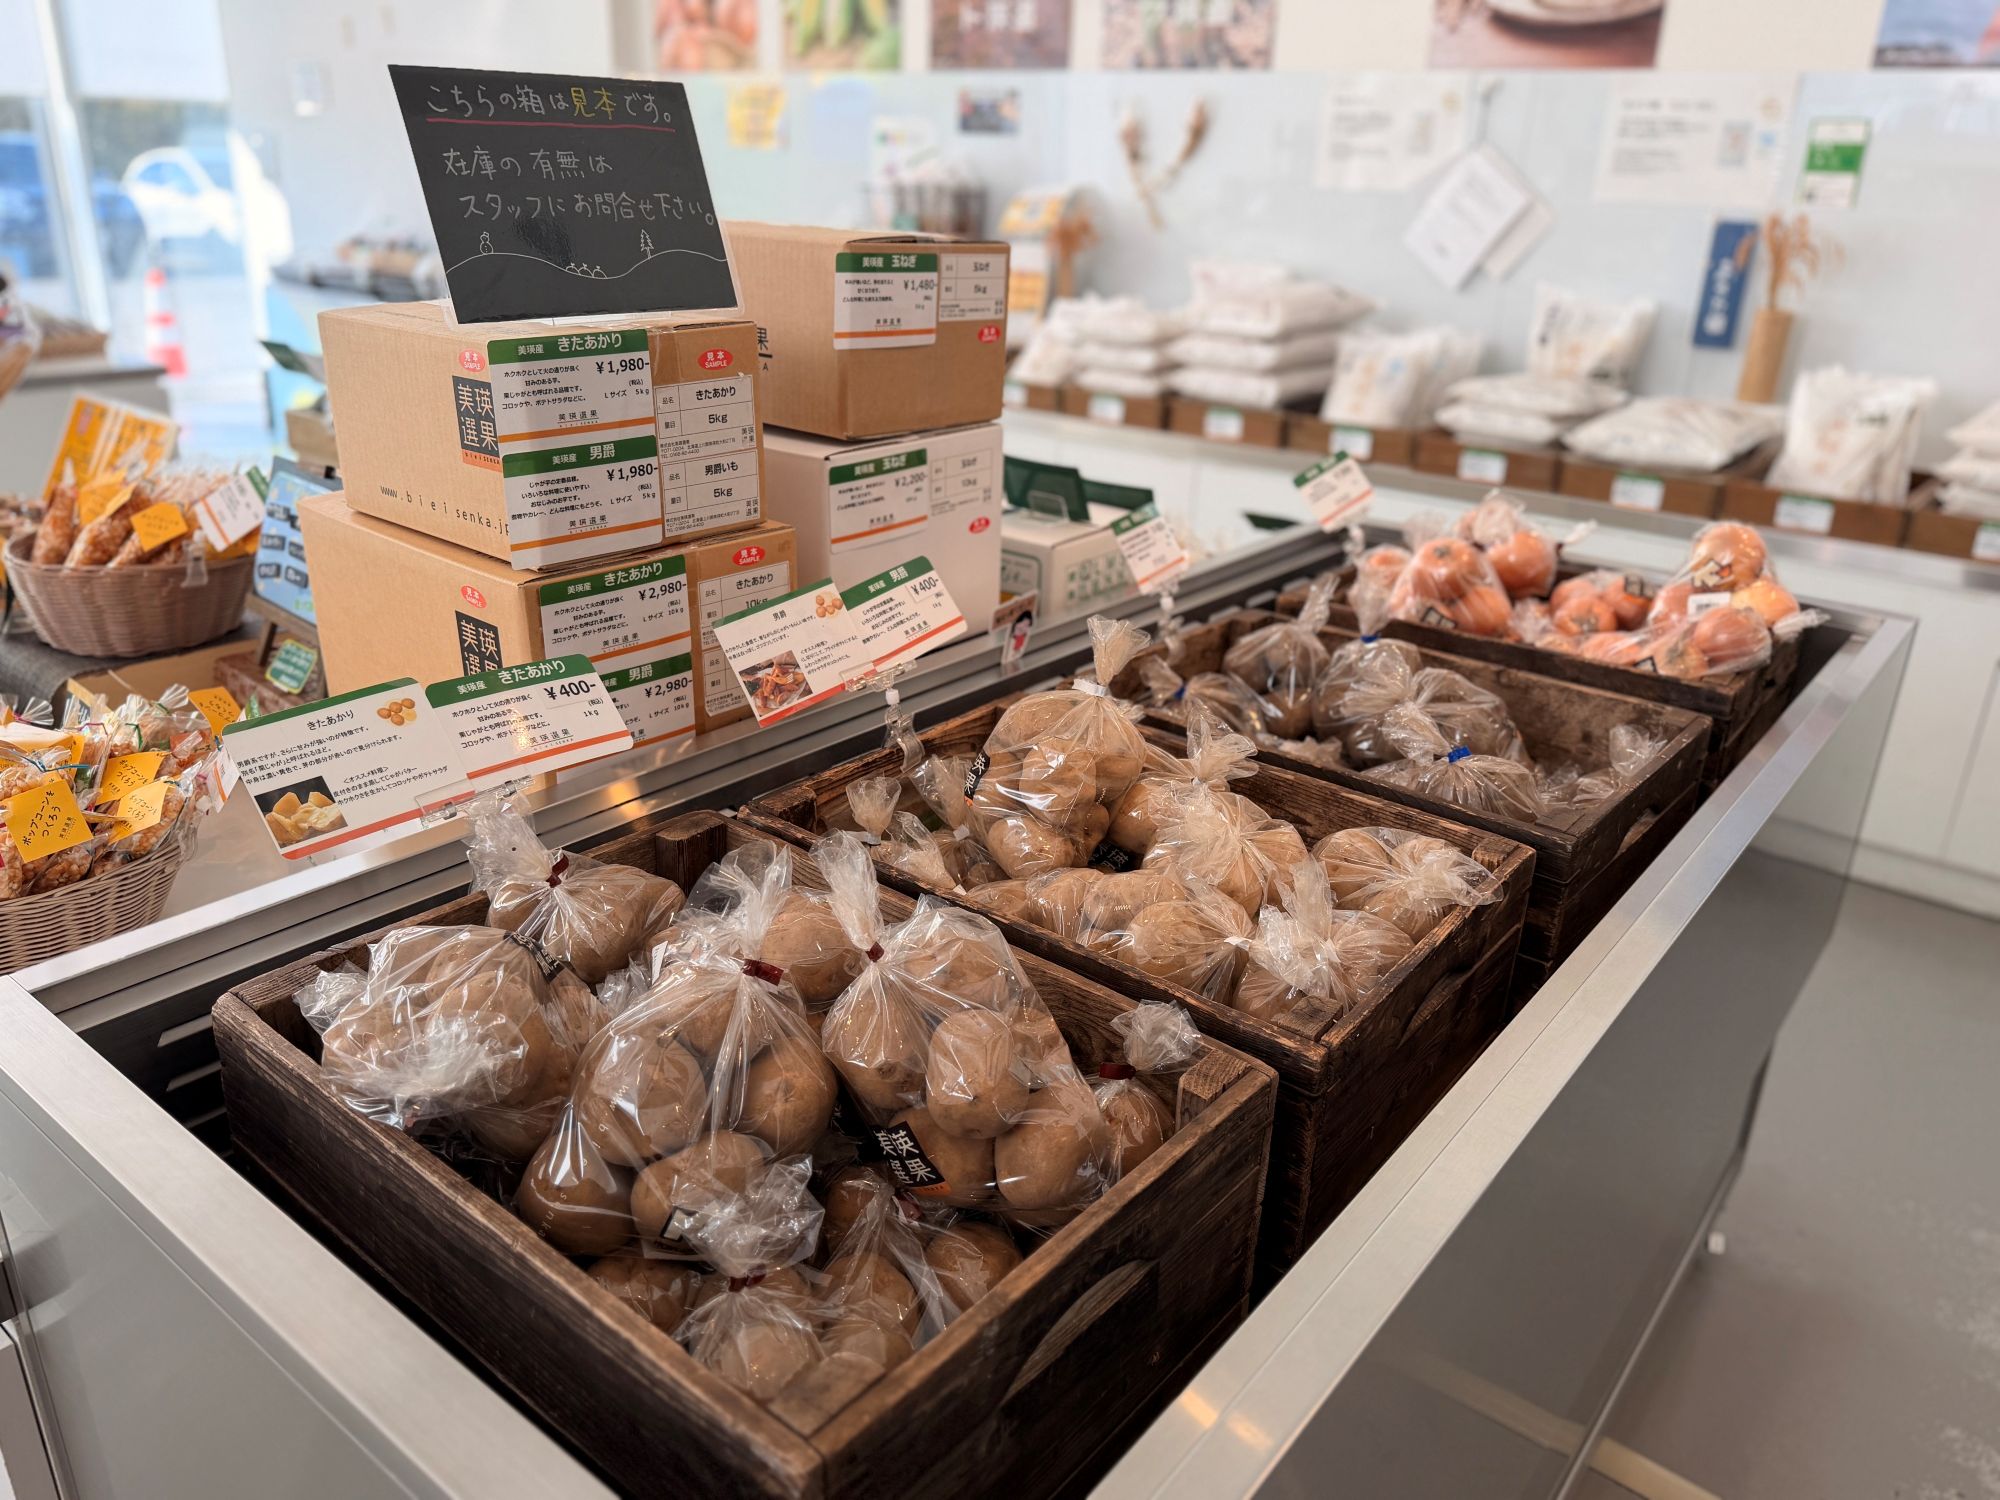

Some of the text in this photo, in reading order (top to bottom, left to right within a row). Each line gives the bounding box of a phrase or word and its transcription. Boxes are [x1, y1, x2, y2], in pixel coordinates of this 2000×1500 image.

[427, 84, 673, 123] こちらの箱は見本です。
[443, 145, 613, 180] 在庫の有無は
[459, 192, 715, 226] スタッフにお問合せ下さい。
[892, 254, 917, 268] 玉ねぎ
[518, 333, 622, 355] 美瑛産 きたあかり
[705, 360, 727, 369] SAMPLE
[707, 350, 725, 361] 見本
[596, 357, 650, 376] ¥1,980-
[696, 385, 736, 401] きたあかり
[708, 413, 728, 425] 5kg
[552, 443, 616, 465] 美瑛産 男爵
[606, 463, 659, 482] ¥1,980-
[705, 461, 738, 476] 男爵いも
[713, 487, 732, 498] 5kg
[738, 556, 761, 565] SAMPLE
[567, 562, 663, 595] 美瑛産 きたあかり
[736, 573, 774, 590] きたあかり
[911, 576, 939, 595] ¥400-
[638, 580, 687, 602] ¥2,980-
[457, 660, 566, 694] 美瑛産 きたあかり
[629, 664, 653, 682] 男爵
[544, 680, 597, 701] ¥400-
[645, 677, 693, 698] ¥2,980-
[307, 710, 354, 731] きたあかり
[583, 710, 599, 718] 1kg
[22, 790, 54, 845] ポップコーンを
[42, 806, 61, 837] つくろう
